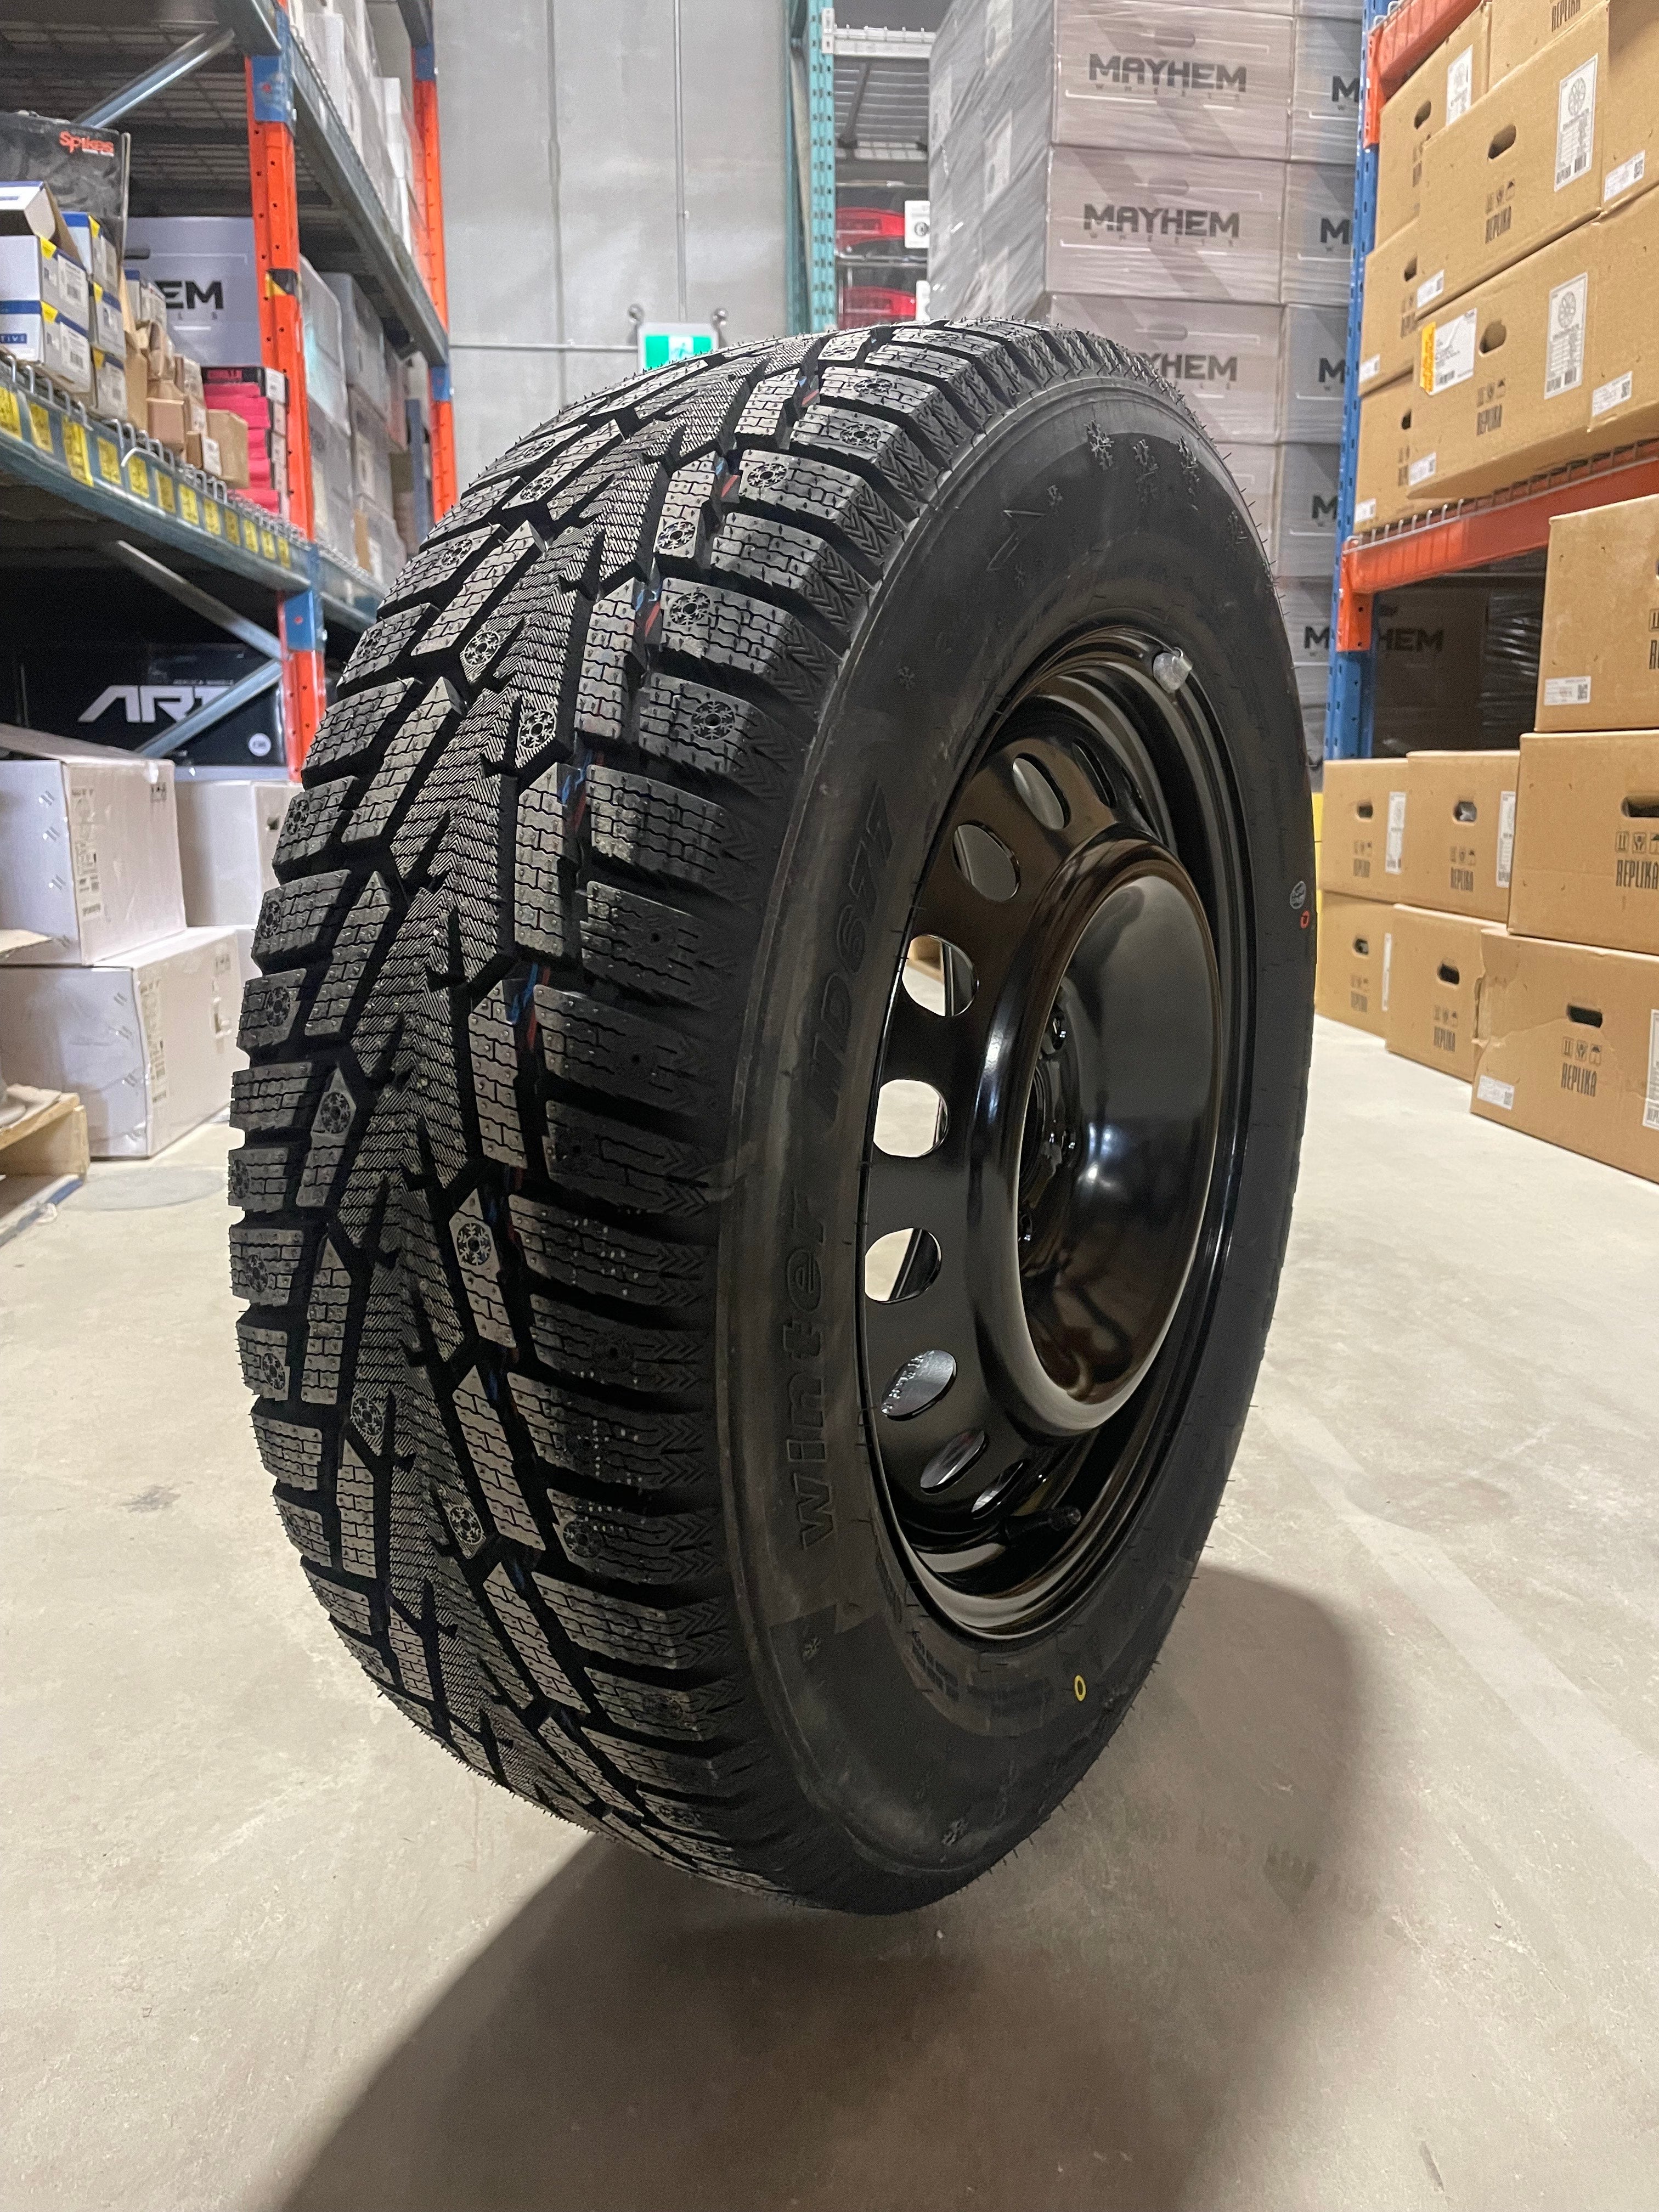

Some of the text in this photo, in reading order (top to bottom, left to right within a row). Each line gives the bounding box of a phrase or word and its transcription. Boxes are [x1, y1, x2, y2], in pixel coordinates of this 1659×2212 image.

[1089, 53, 1247, 92] MAYHEM
[1083, 204, 1239, 238] MAYHEM
[1139, 353, 1237, 381] YHEM
[1615, 860, 1658, 889] REPLIKA
[1561, 1062, 1597, 1097] REPLIKA
